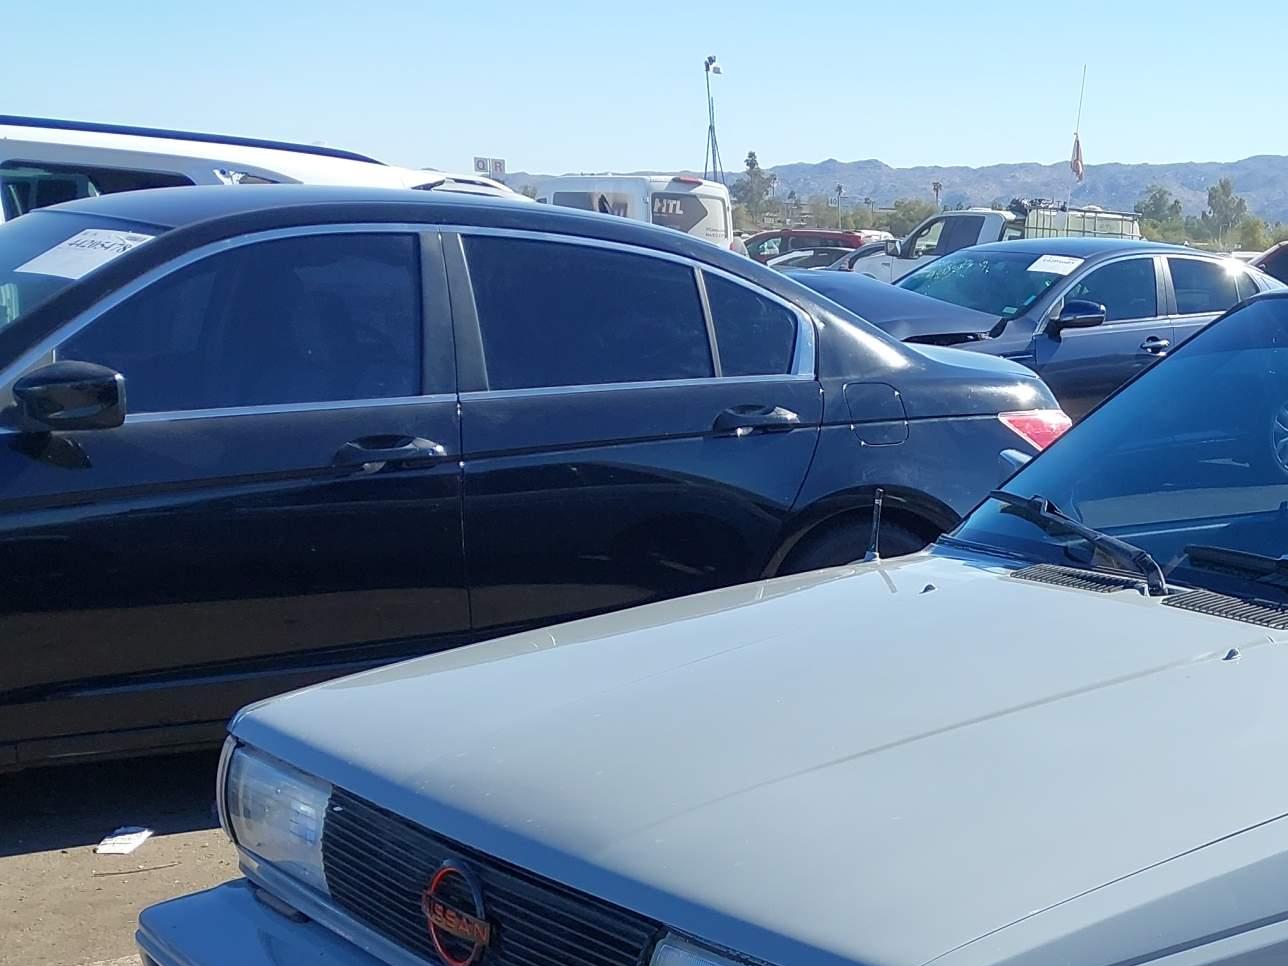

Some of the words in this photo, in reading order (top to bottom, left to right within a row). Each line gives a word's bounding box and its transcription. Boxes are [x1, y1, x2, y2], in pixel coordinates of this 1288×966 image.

[476, 159, 486, 171] Q
[494, 161, 503, 172] R
[654, 198, 684, 215] HTL
